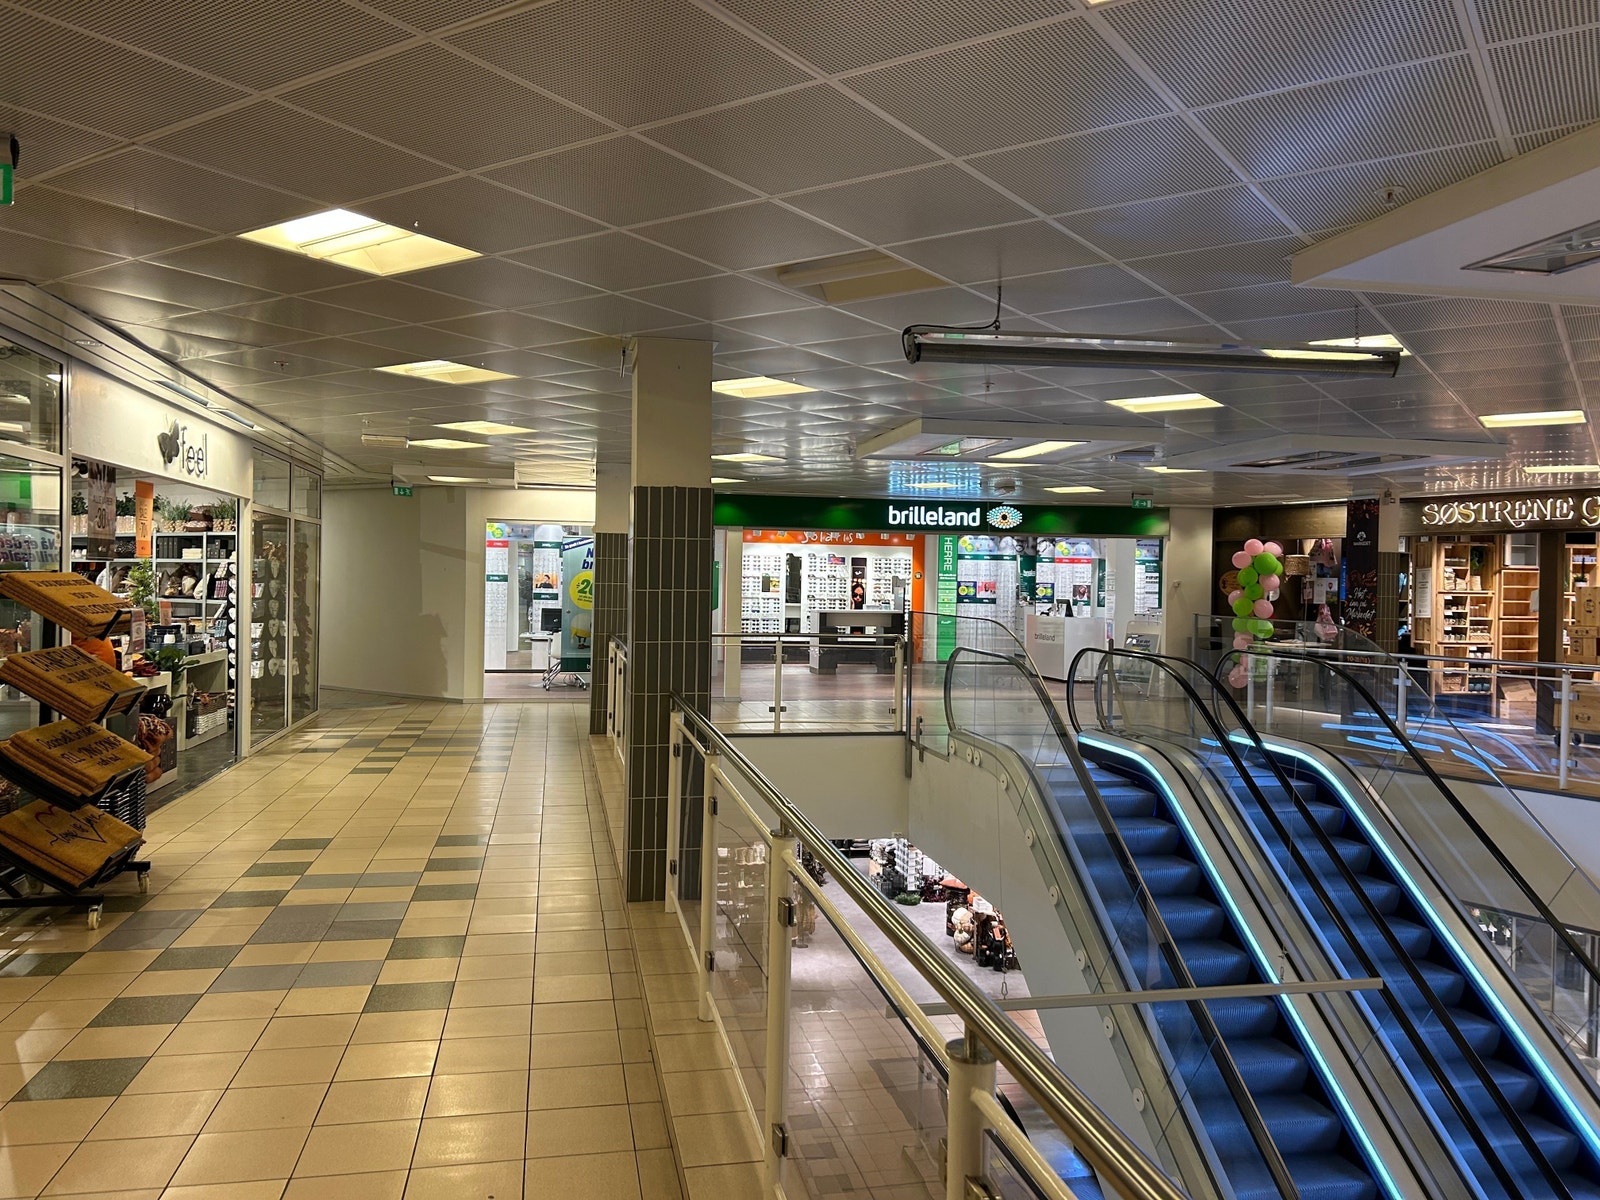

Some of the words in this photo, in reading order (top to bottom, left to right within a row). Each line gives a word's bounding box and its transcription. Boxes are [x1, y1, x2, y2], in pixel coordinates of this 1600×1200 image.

[180, 425, 208, 476] feel
[888, 505, 981, 527] brilleland
[1422, 497, 1575, 528] SØSTRENE
[943, 537, 953, 571] HERRE
[1034, 632, 1056, 642] brilleland
